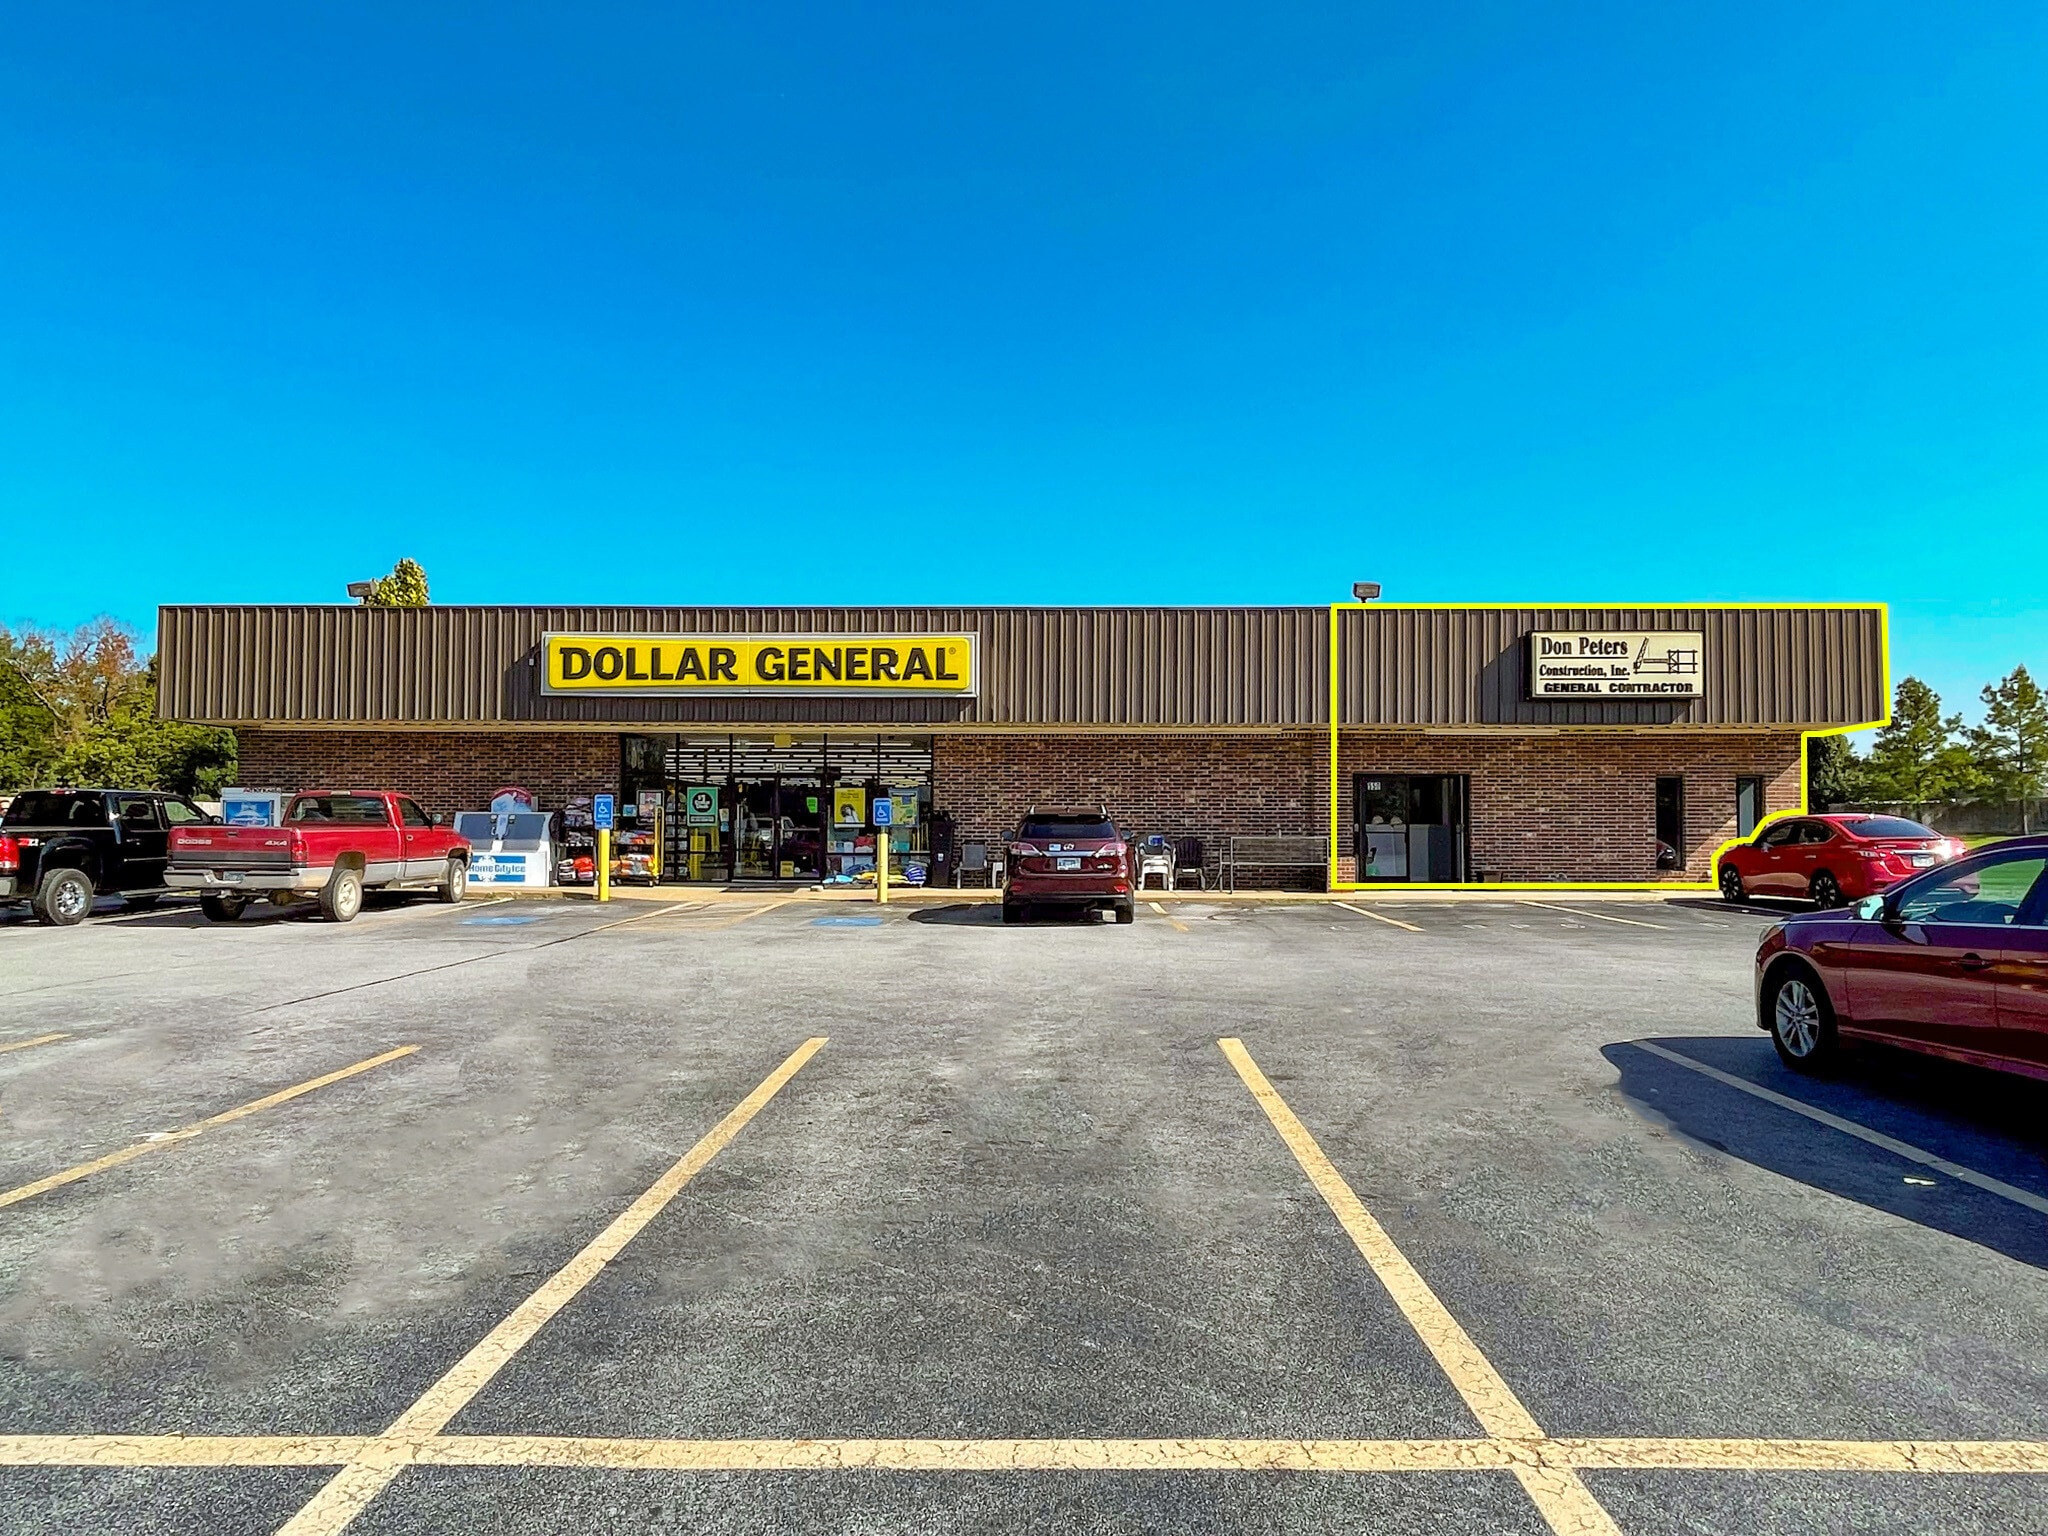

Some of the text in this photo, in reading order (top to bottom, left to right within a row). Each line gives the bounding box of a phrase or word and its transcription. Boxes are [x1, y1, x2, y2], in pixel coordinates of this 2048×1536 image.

[1540, 637, 1629, 655] Don Peters
[559, 646, 959, 681] DOLLAR GENERAL
[1539, 664, 1631, 677] Construction, Inc.
[1544, 682, 1693, 693] GENERAL CONTRACTOR
[469, 864, 526, 874] Home City Ice
